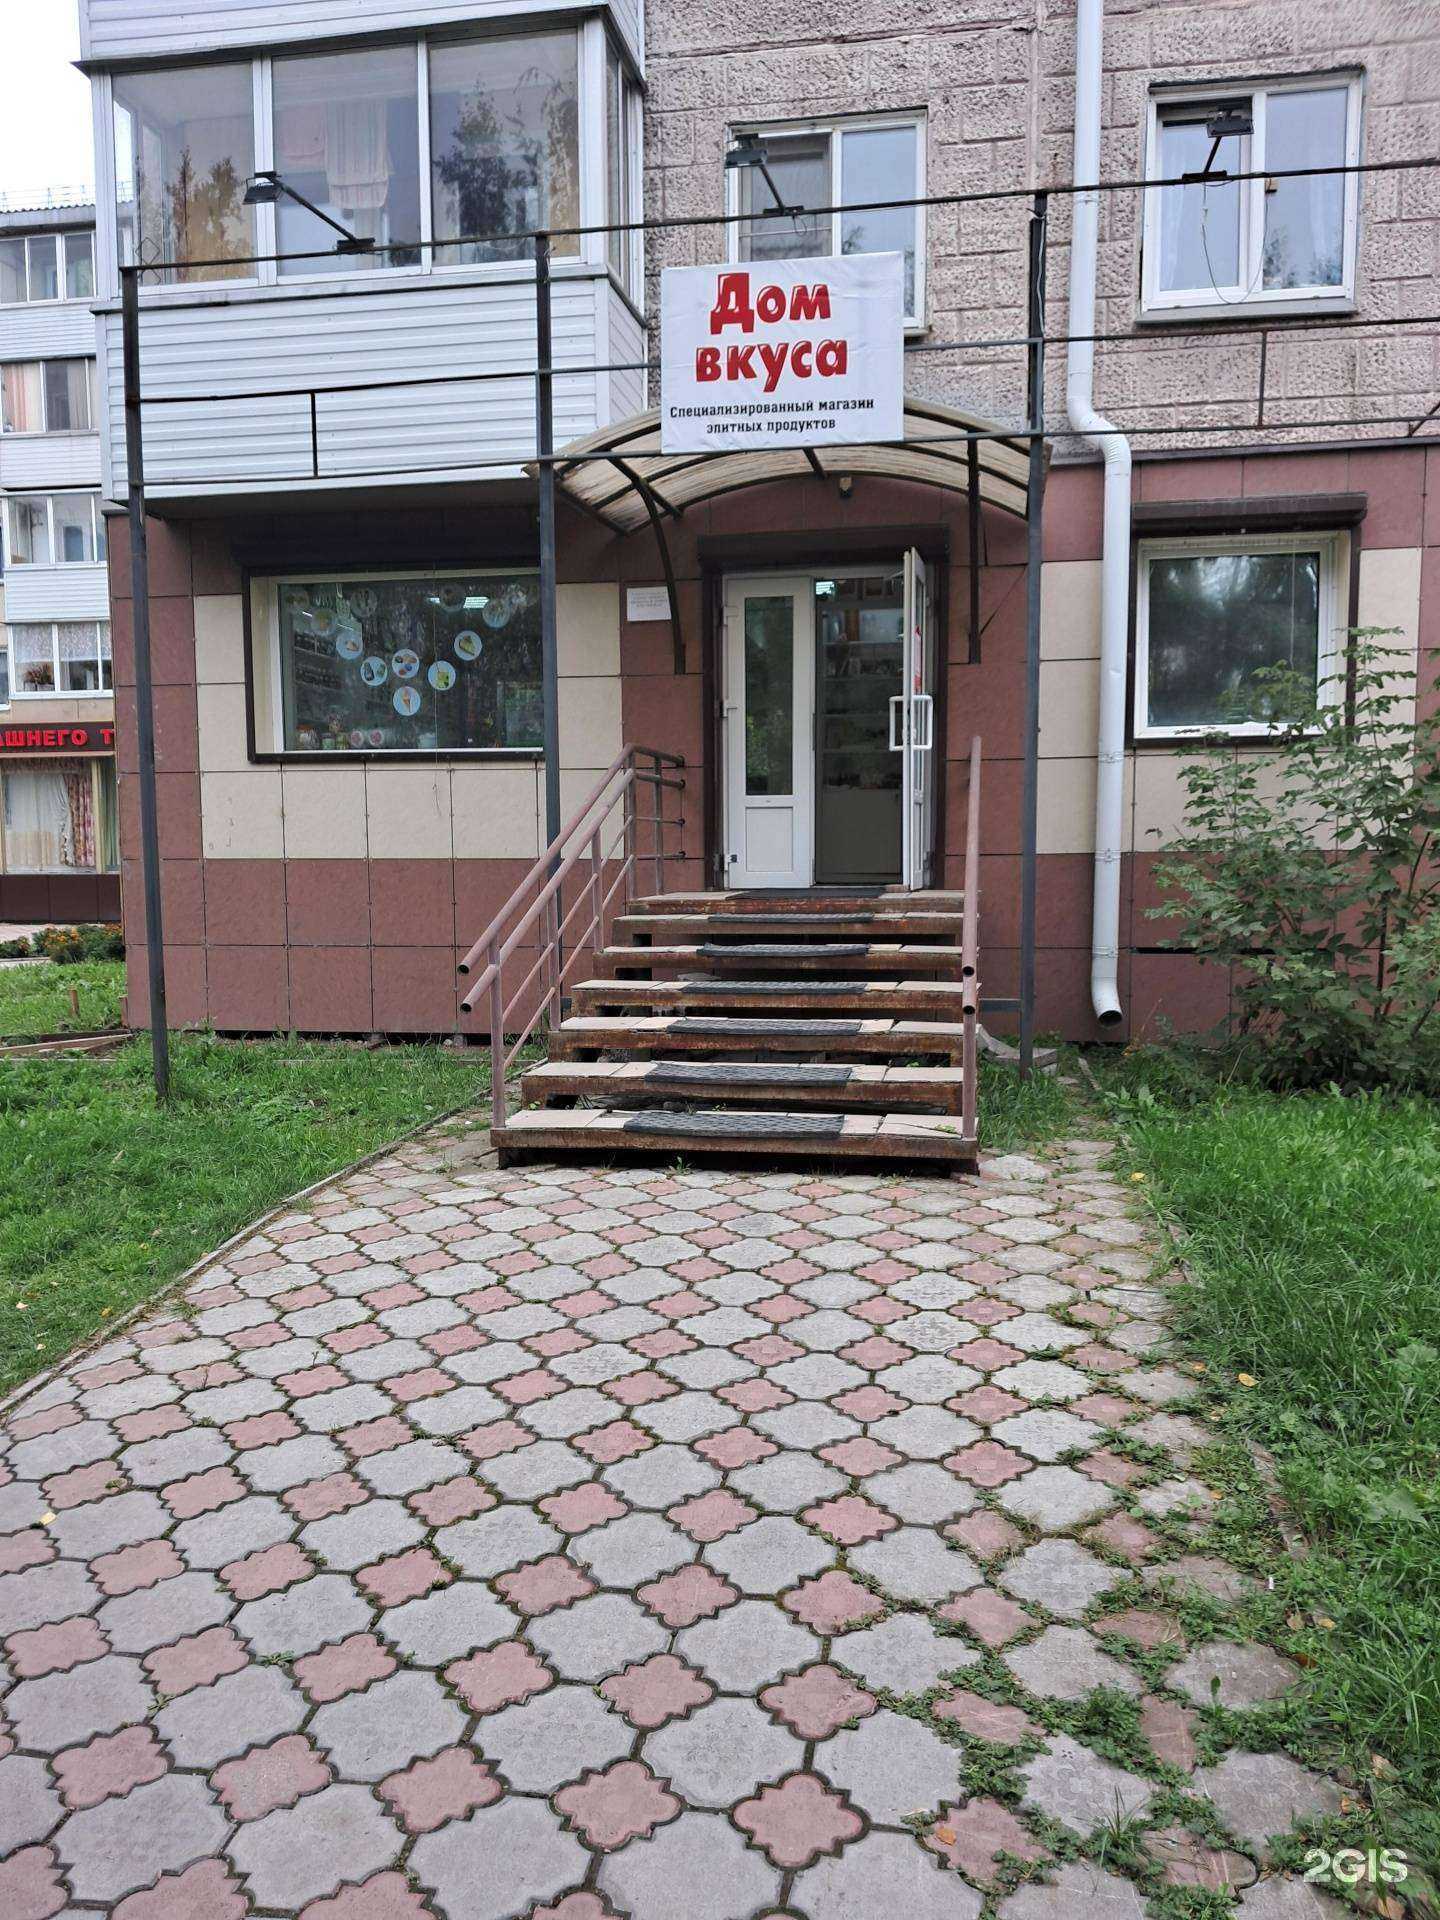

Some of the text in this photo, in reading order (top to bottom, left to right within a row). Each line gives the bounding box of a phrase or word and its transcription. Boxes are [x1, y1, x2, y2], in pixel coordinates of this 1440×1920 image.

[710, 272, 832, 335] Дом
[695, 339, 847, 393] вкуса
[670, 398, 875, 418] Специализированный магазин
[706, 418, 836, 434] элитных продуктов
